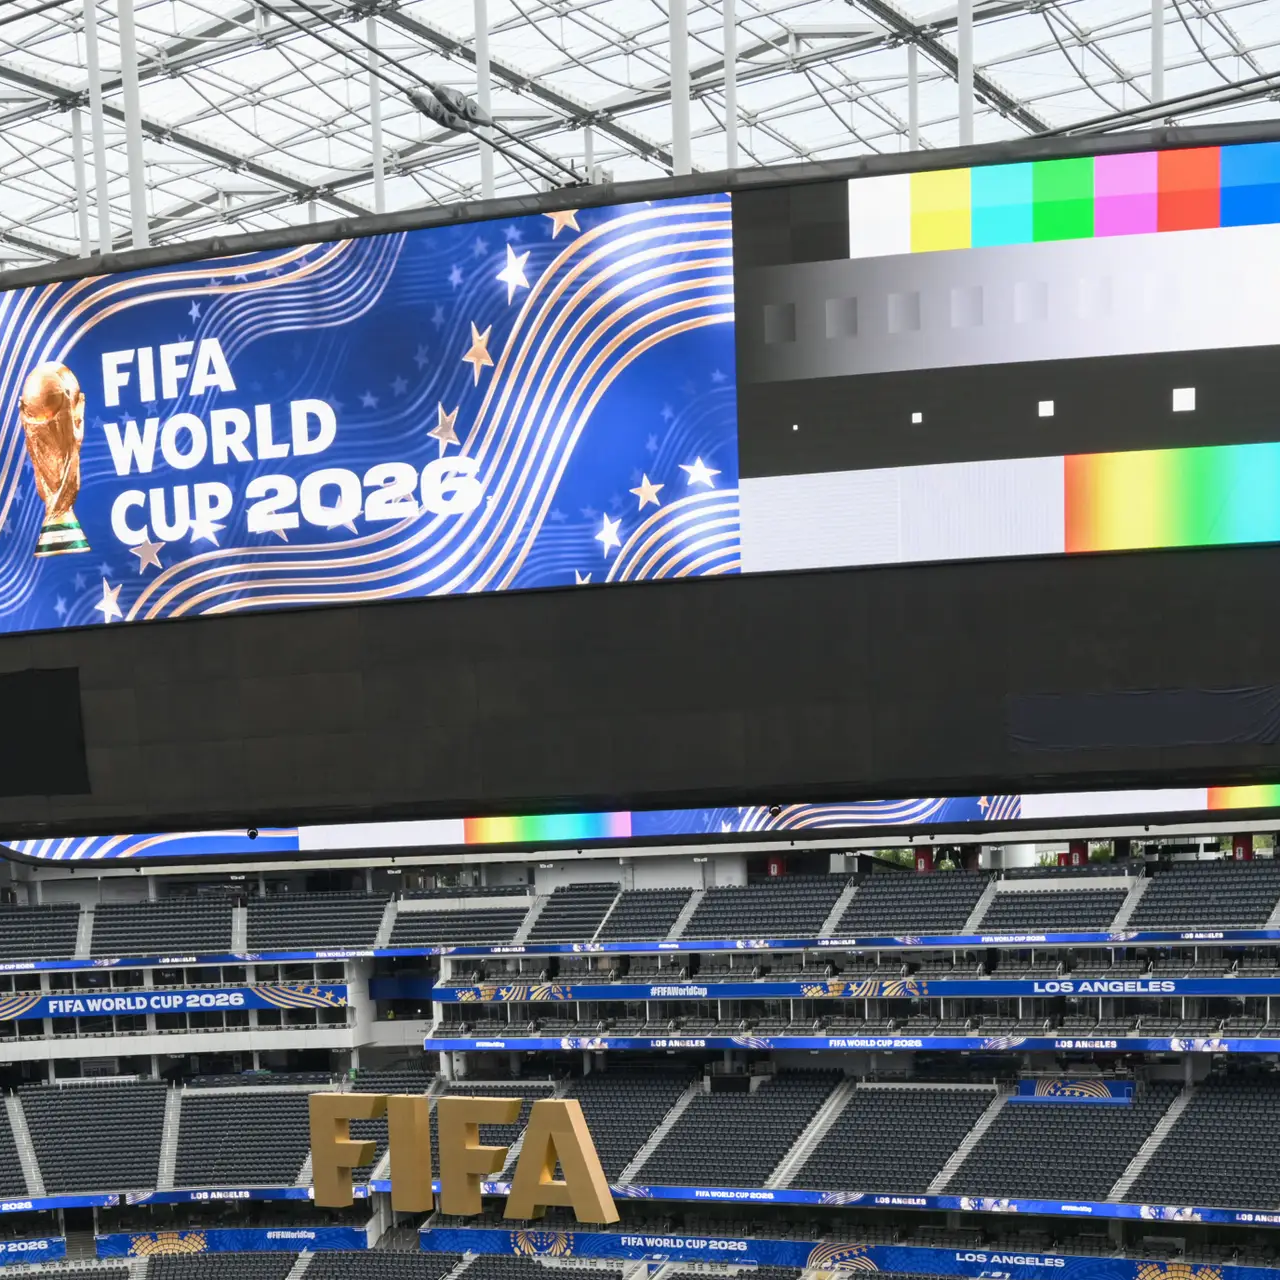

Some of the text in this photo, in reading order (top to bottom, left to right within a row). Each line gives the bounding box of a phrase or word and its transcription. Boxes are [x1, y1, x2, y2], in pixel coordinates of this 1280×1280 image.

[101, 337, 236, 407] FIFA
[103, 398, 337, 476] WORLD
[111, 455, 483, 546] CUP 2026
[650, 985, 708, 998] #FIFAWorldCup
[1034, 981, 1177, 993] LOS ANGELES
[49, 993, 245, 1014] FIFA WORLD CUP 2026
[651, 1039, 706, 1048] LOS ANGELES
[829, 1040, 846, 1048] FIFA
[847, 1040, 875, 1048] WORLD
[877, 1039, 893, 1048] CUP
[1054, 1040, 1117, 1049] LOS ANGELES
[308, 1093, 620, 1224] FIFA
[191, 1190, 251, 1200] LOS ANGELES
[875, 1196, 927, 1206] LOS ANGELES
[2, 1201, 33, 1211] 2026
[1235, 1213, 1253, 1222] LOS
[8, 1240, 49, 1252] 2026
[621, 1236, 748, 1251] FIFA WORLD CUP 2026
[955, 1252, 1066, 1268] LOS ANGELES
